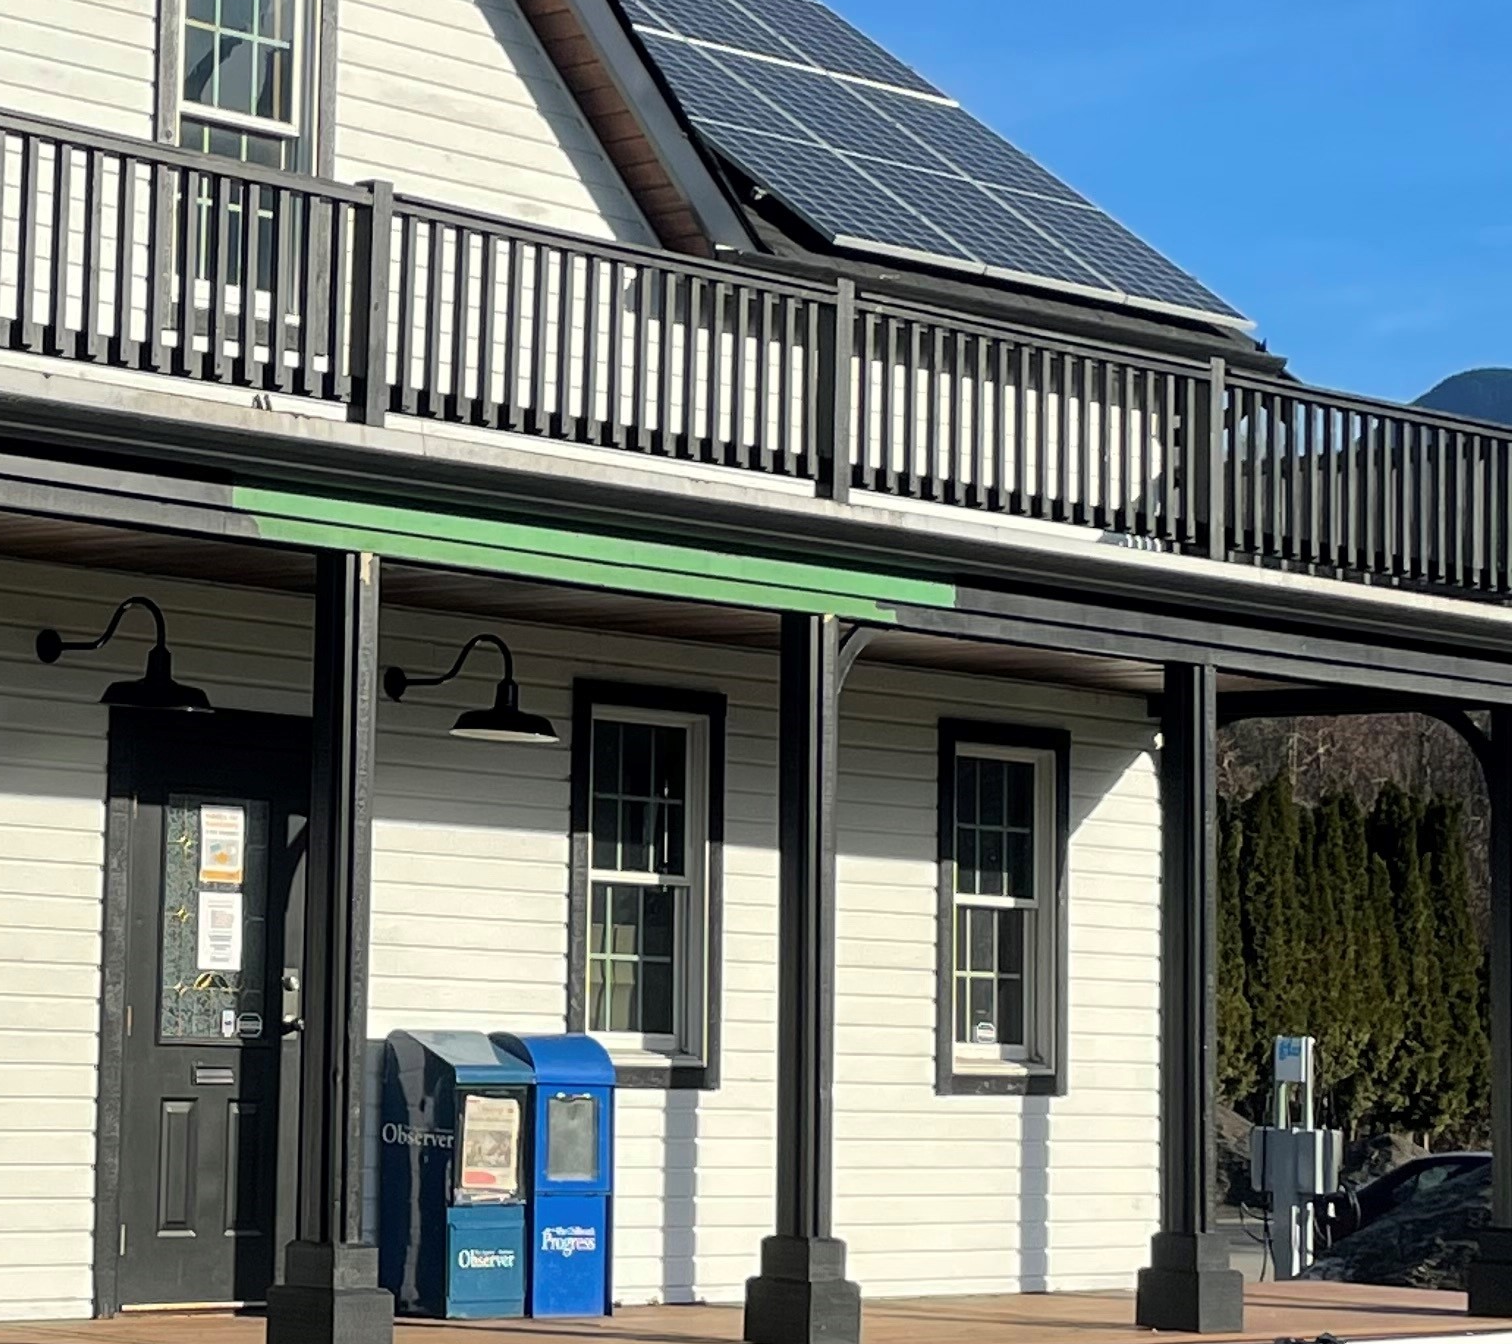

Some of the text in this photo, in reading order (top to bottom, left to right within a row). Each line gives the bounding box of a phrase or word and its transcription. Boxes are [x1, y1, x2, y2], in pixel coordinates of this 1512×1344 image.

[381, 1122, 455, 1149] Observer
[541, 1227, 596, 1257] Progress
[458, 1249, 515, 1269] Observer
